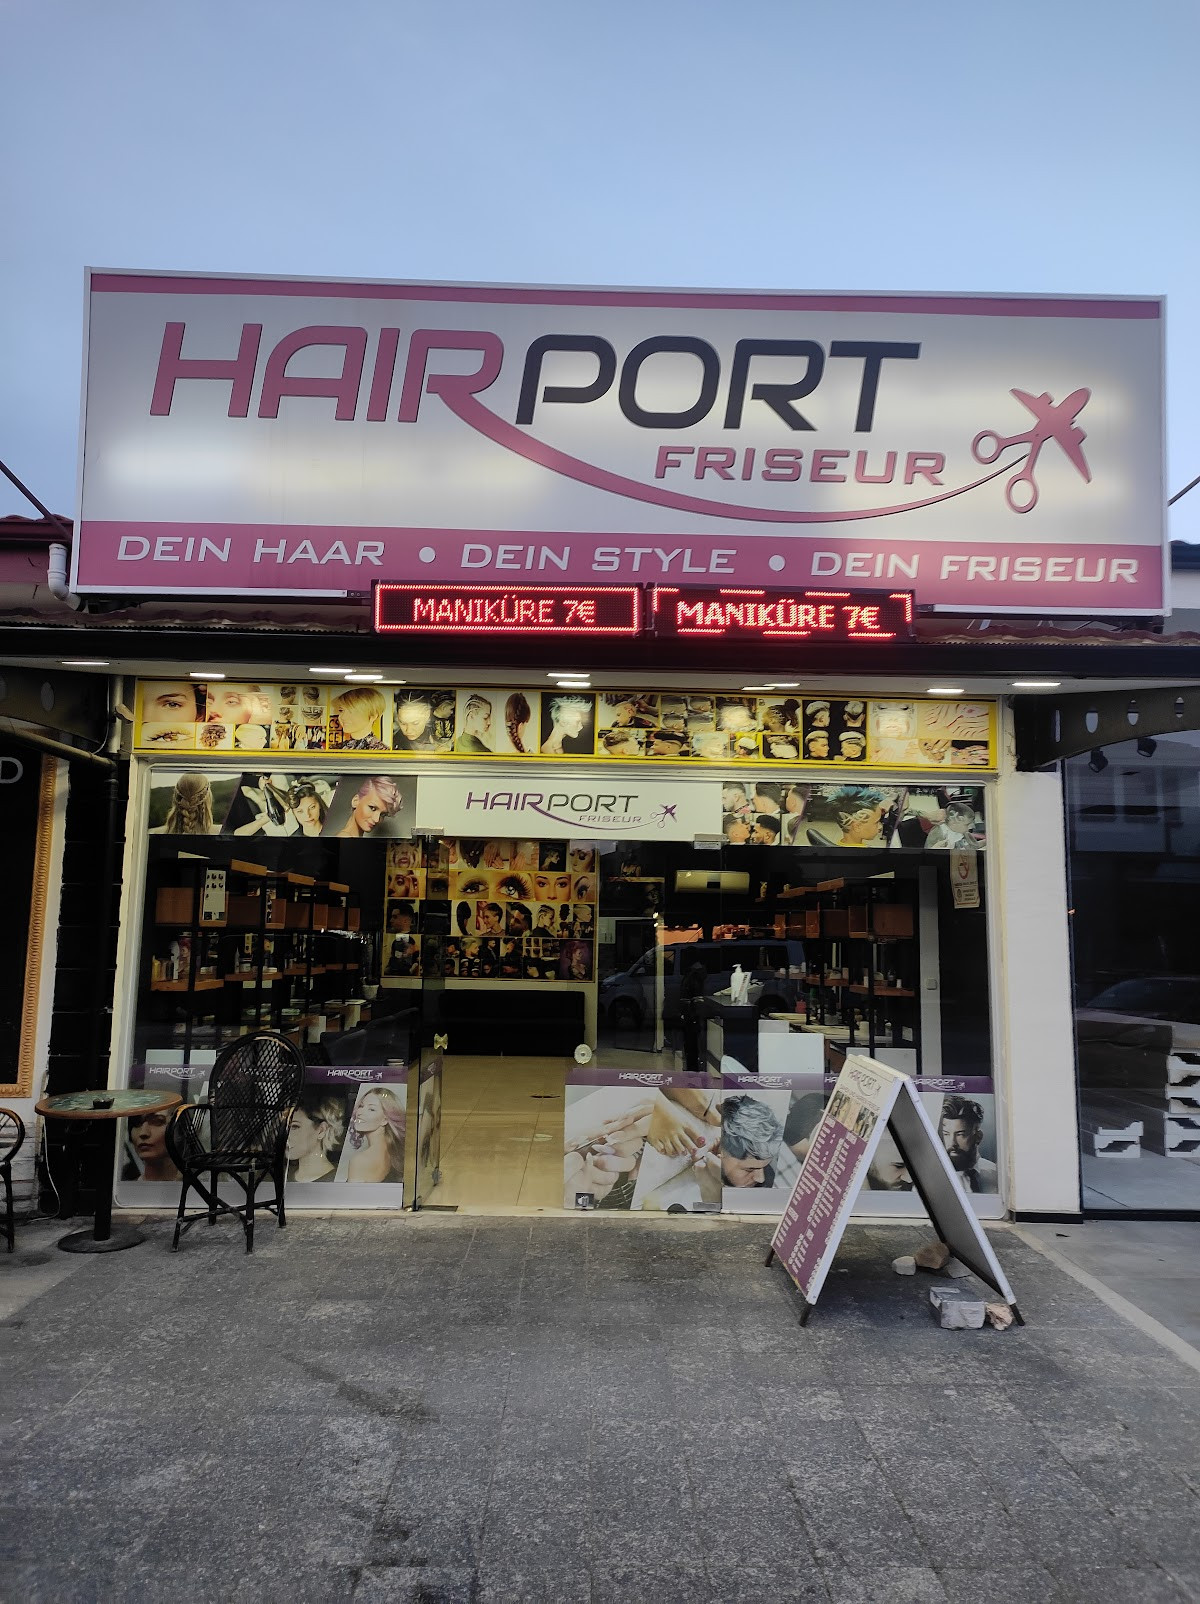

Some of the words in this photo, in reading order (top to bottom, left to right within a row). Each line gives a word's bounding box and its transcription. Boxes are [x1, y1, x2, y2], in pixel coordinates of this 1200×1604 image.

[150, 321, 922, 433] HAIRPORT
[654, 445, 946, 486] FRISEUR
[116, 535, 232, 563] DEIN
[253, 538, 385, 566] HAAR
[460, 543, 570, 571] DEIN
[592, 546, 738, 574] STYLE
[811, 551, 919, 579] DEIN
[939, 555, 1139, 584] FRISEUR
[412, 594, 554, 623] MANIKÜRE
[563, 600, 596, 624] 7€
[676, 598, 835, 630] MANIKÜRE
[843, 605, 880, 630] 7€
[465, 791, 639, 813] HAIRPORT
[578, 814, 642, 824] FRISEUR
[149, 1067, 196, 1075] HAIRPORT
[327, 1069, 374, 1077] HAIRPORT
[618, 1072, 664, 1081] HAIRPORT
[737, 1075, 782, 1083] HAIRPORT
